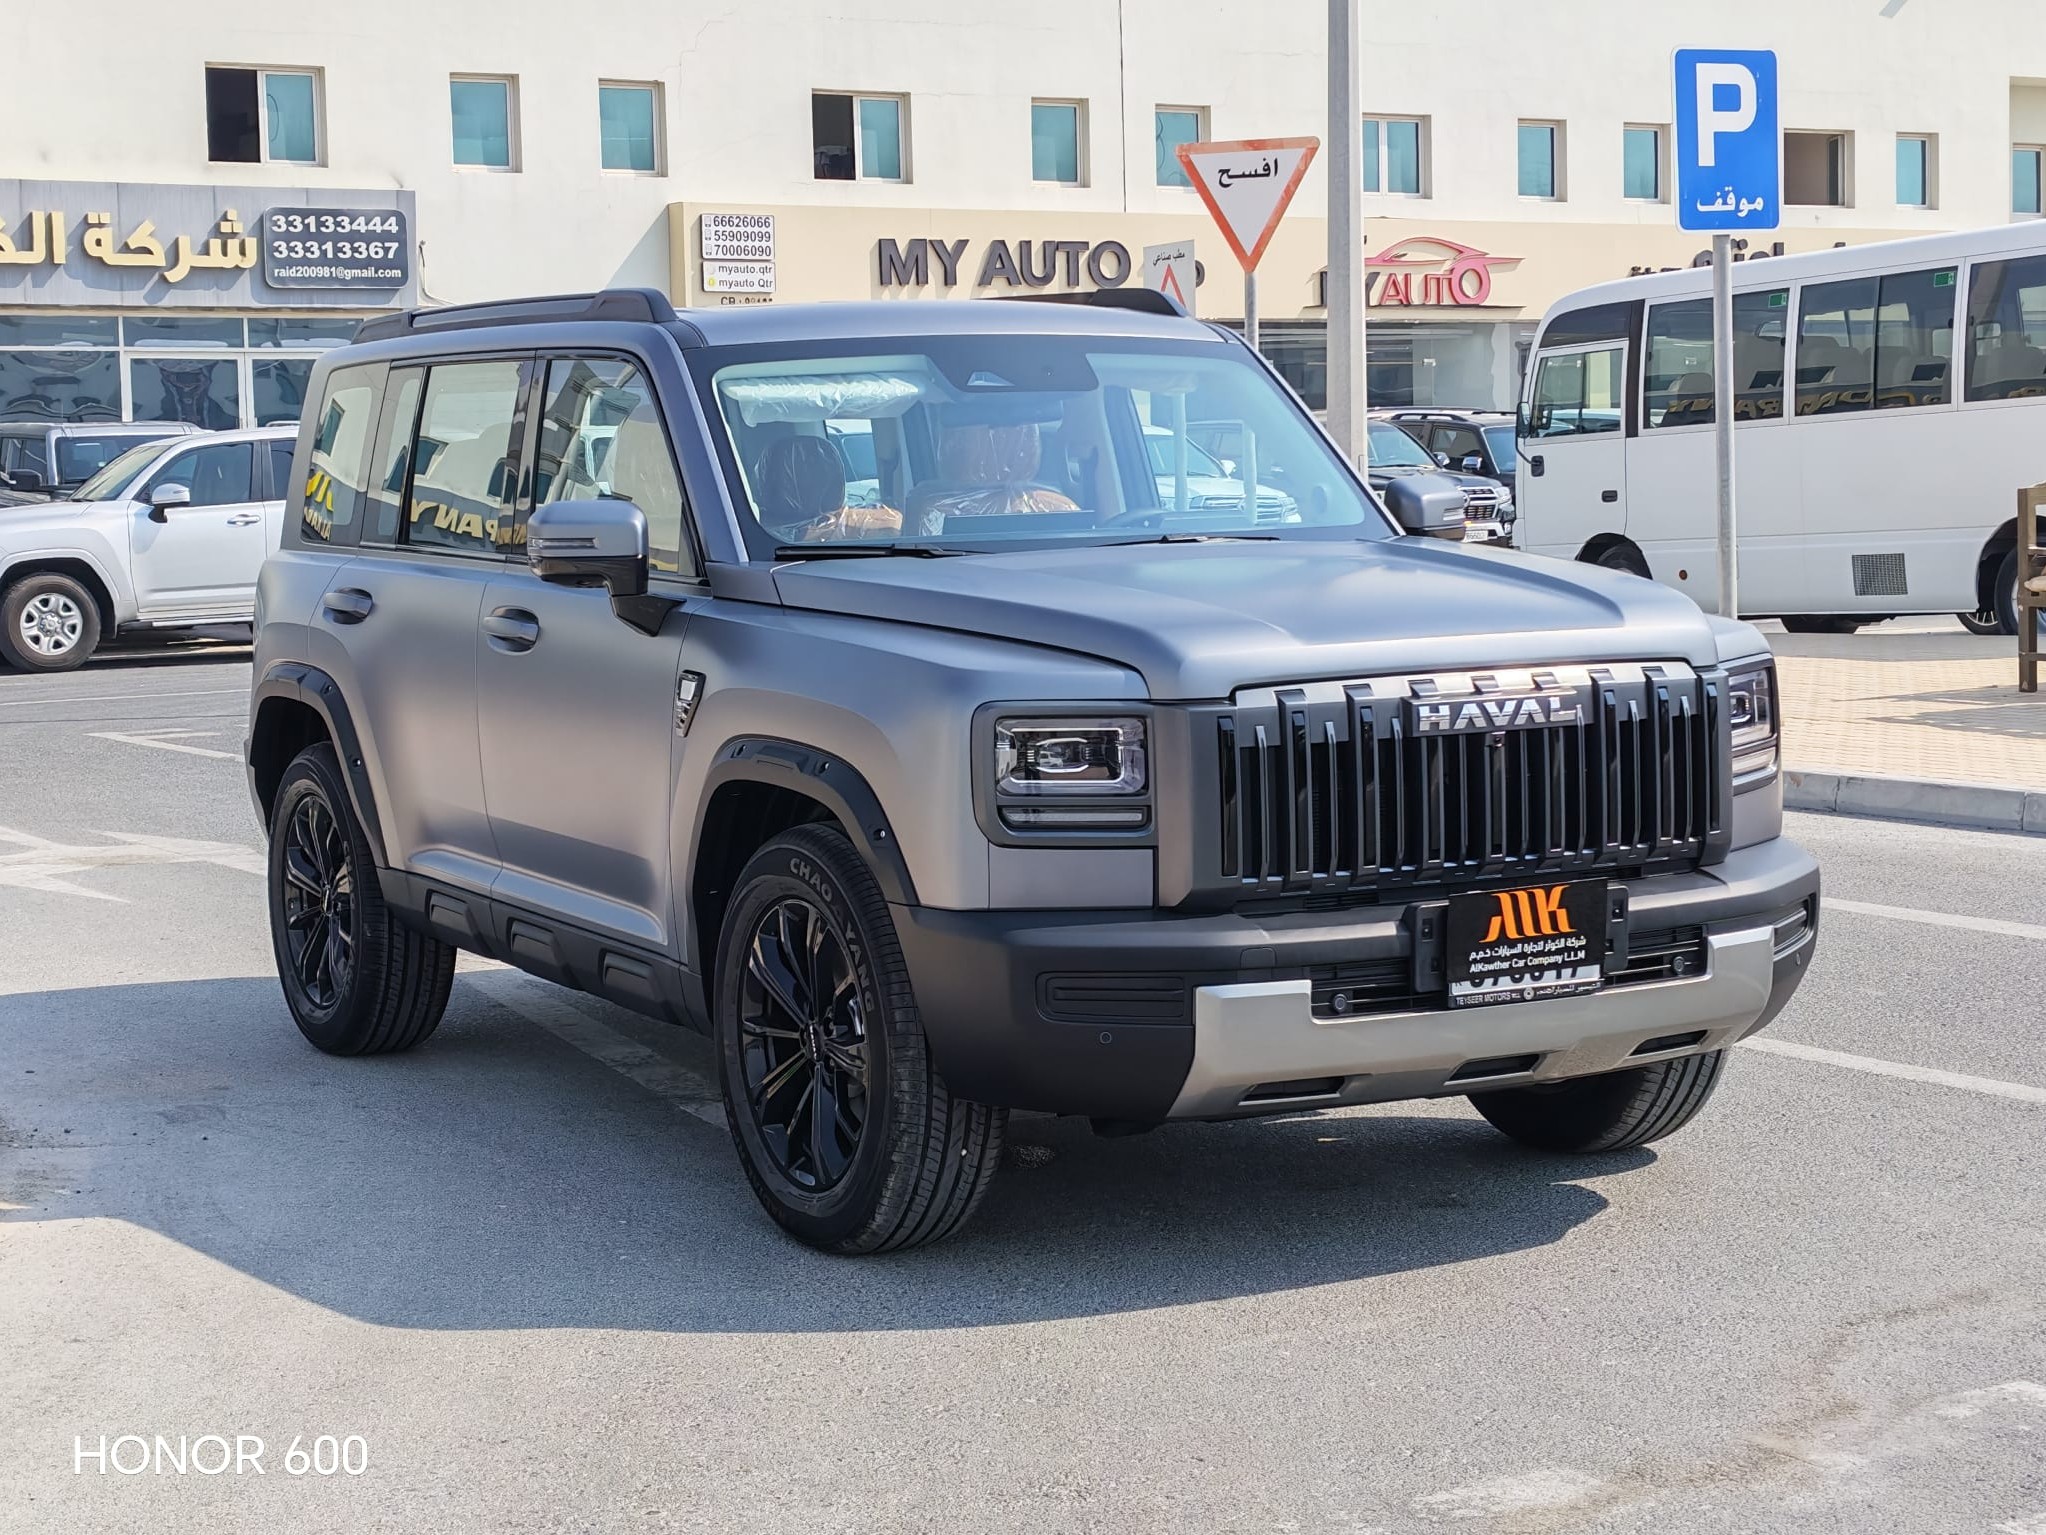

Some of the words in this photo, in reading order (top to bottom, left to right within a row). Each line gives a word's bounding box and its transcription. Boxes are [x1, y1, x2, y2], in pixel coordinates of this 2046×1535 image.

[1696, 62, 1757, 166] P
[1218, 157, 1278, 188] افسح
[1696, 186, 1764, 217] موقف
[271, 215, 399, 234] 33133444
[713, 216, 771, 228] 66626066
[714, 230, 771, 242] 55909099
[83, 209, 258, 283] شركة
[272, 241, 399, 259] 33313367
[714, 244, 772, 257] 70006090
[718, 265, 773, 276] myauto.qtr
[878, 238, 970, 287] MY
[978, 239, 1132, 288] AUTO
[273, 265, 402, 280] raid200981@gmail.com
[718, 279, 755, 290] myauto
[758, 278, 774, 289] Qtr
[1380, 261, 1491, 305] AUTO
[1418, 697, 1576, 731] HAVAL
[789, 857, 832, 903] CHAO
[1566, 936, 1587, 948] شركة
[1512, 958, 1525, 967] Car
[1527, 954, 1563, 966] Company
